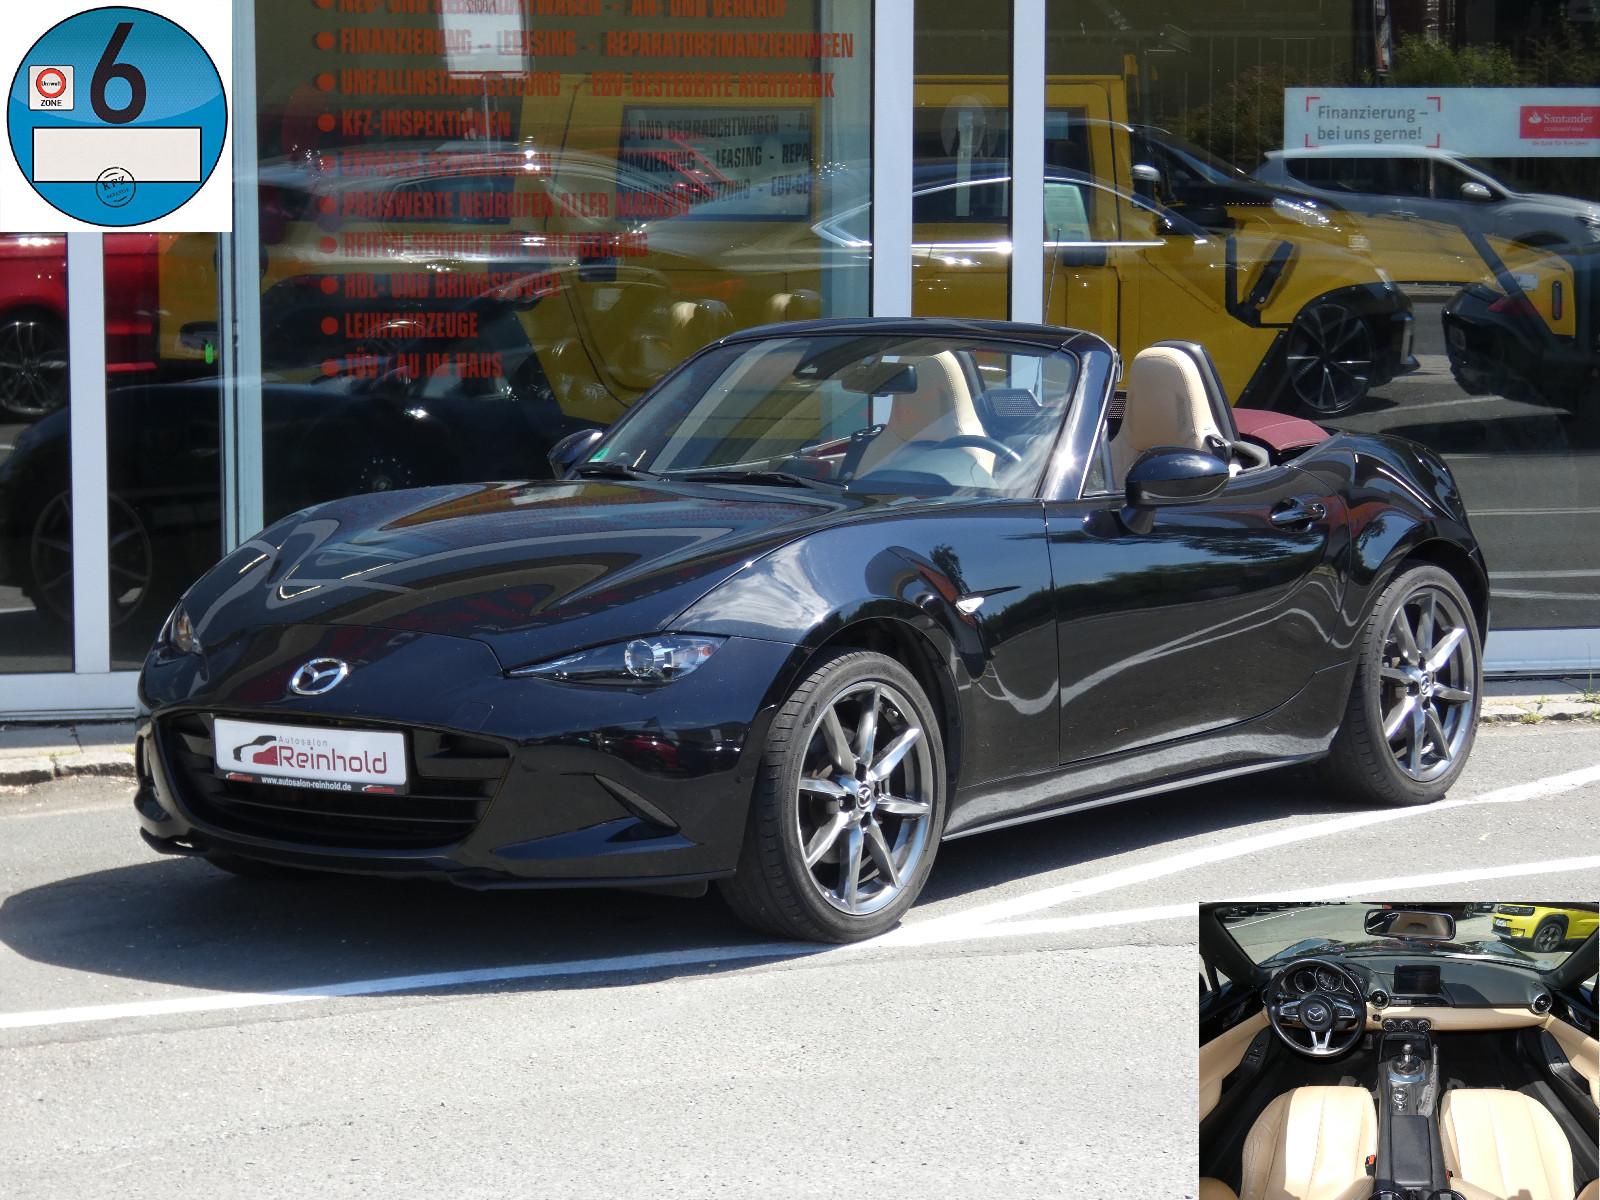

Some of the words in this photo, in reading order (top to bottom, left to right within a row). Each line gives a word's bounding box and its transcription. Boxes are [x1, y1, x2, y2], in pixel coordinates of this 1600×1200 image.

[341, 110, 511, 137] KFZ-INSPEKTIONEN
[1318, 106, 1415, 122] Finanzierung
[1543, 113, 1593, 124] Santander
[1317, 126, 1340, 140] bei
[1344, 128, 1370, 140] uns
[1374, 126, 1422, 143] gerne!
[716, 146, 763, 169] LEASING
[342, 192, 454, 217] PREISWERTE
[459, 192, 553, 217] NEUREIFEN
[560, 192, 609, 217] ALLER
[391, 272, 430, 298] UND
[345, 312, 480, 338] LEIHFAHRZEUGE
[345, 347, 378, 379] TÜV
[397, 352, 422, 378] AU
[427, 352, 450, 378] IM
[456, 352, 504, 378] HAUS
[277, 735, 328, 748] Autosalon
[277, 745, 388, 775] Reinhold
[261, 776, 352, 791] www.autosalon-reinhold.de
